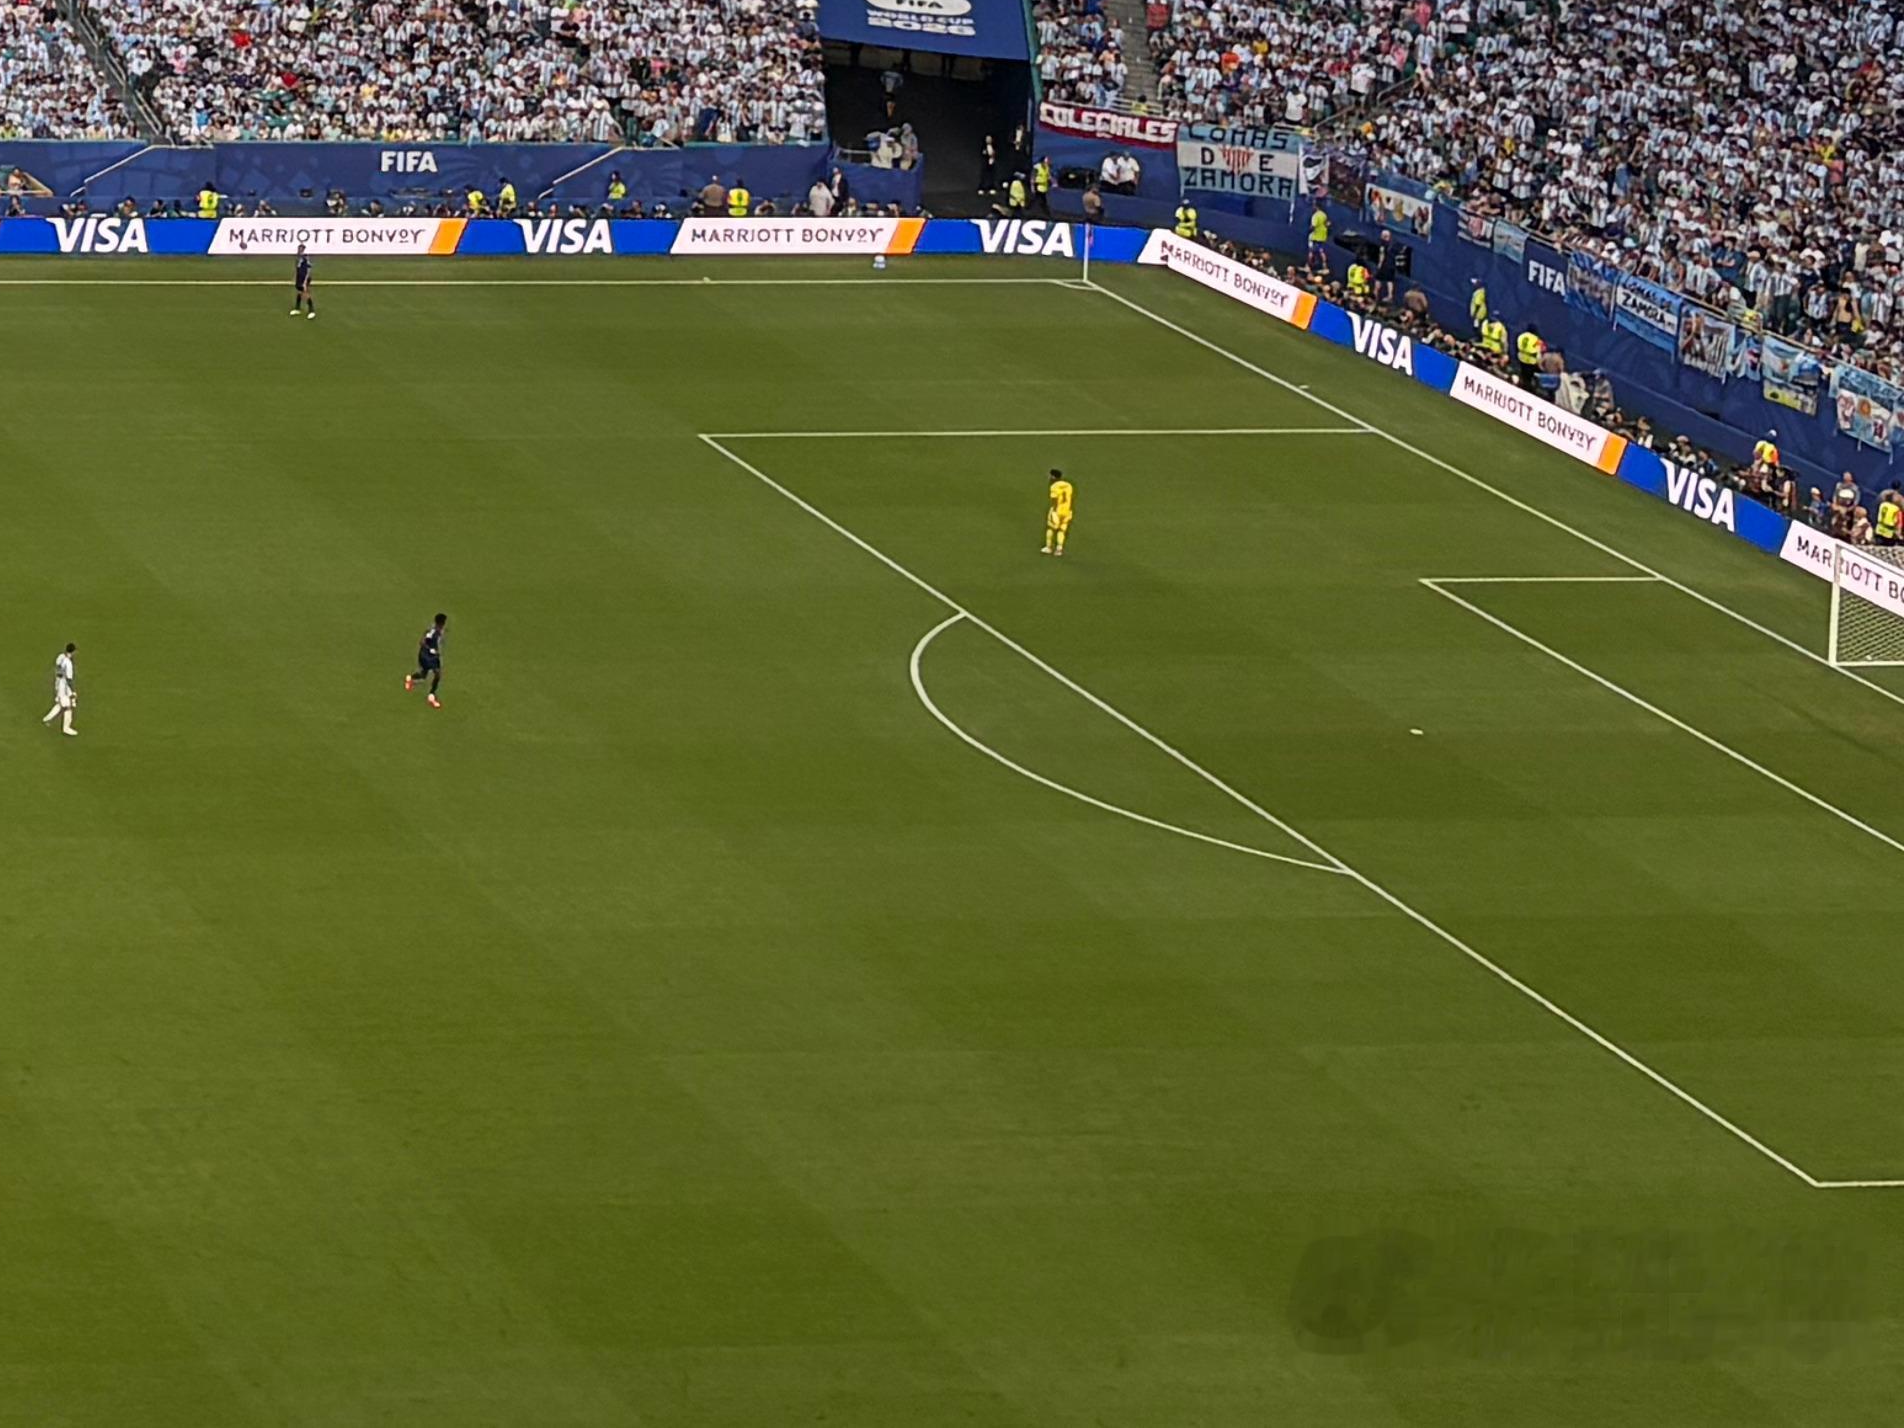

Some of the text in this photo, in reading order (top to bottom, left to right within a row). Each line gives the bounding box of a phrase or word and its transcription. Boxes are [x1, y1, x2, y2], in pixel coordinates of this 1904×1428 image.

[1039, 102, 1179, 144] COLEGIALES
[380, 150, 438, 174] FIFA
[1183, 169, 1293, 201] ZAMORA
[54, 217, 149, 254] VISA
[229, 227, 335, 246] MARRIOTT
[520, 218, 614, 255] VISA
[690, 227, 796, 244] MARRIOTT
[977, 219, 1075, 256] VISA
[1527, 259, 1567, 298] FIFA
[1349, 310, 1414, 376] VISA
[1463, 374, 1535, 424] MARRIOTT
[1664, 458, 1737, 533] VISA
